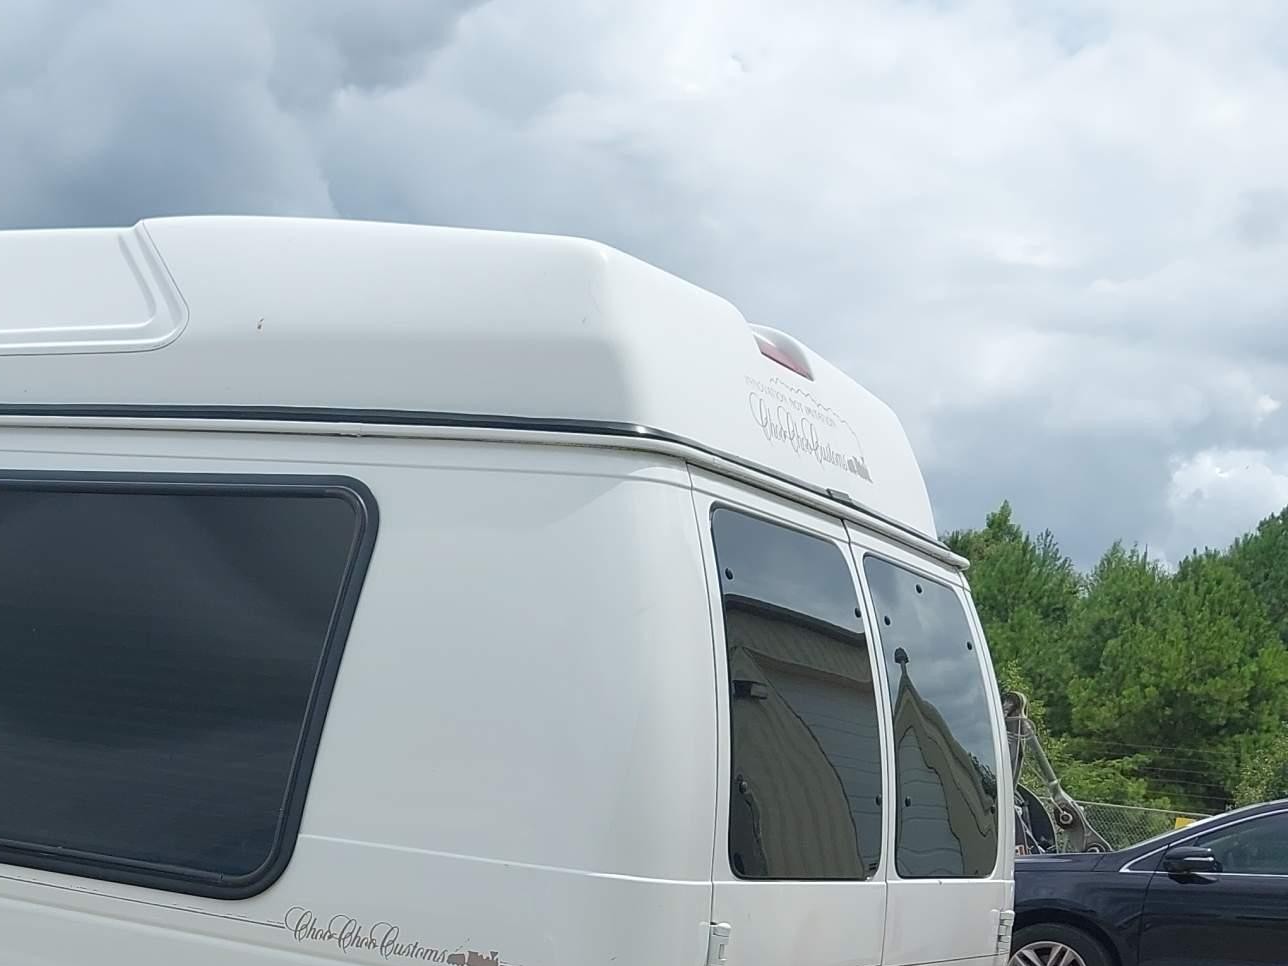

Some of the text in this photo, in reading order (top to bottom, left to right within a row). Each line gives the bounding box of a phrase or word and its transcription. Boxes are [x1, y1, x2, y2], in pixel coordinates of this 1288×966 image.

[284, 906, 448, 960] Choo Choo Customs
